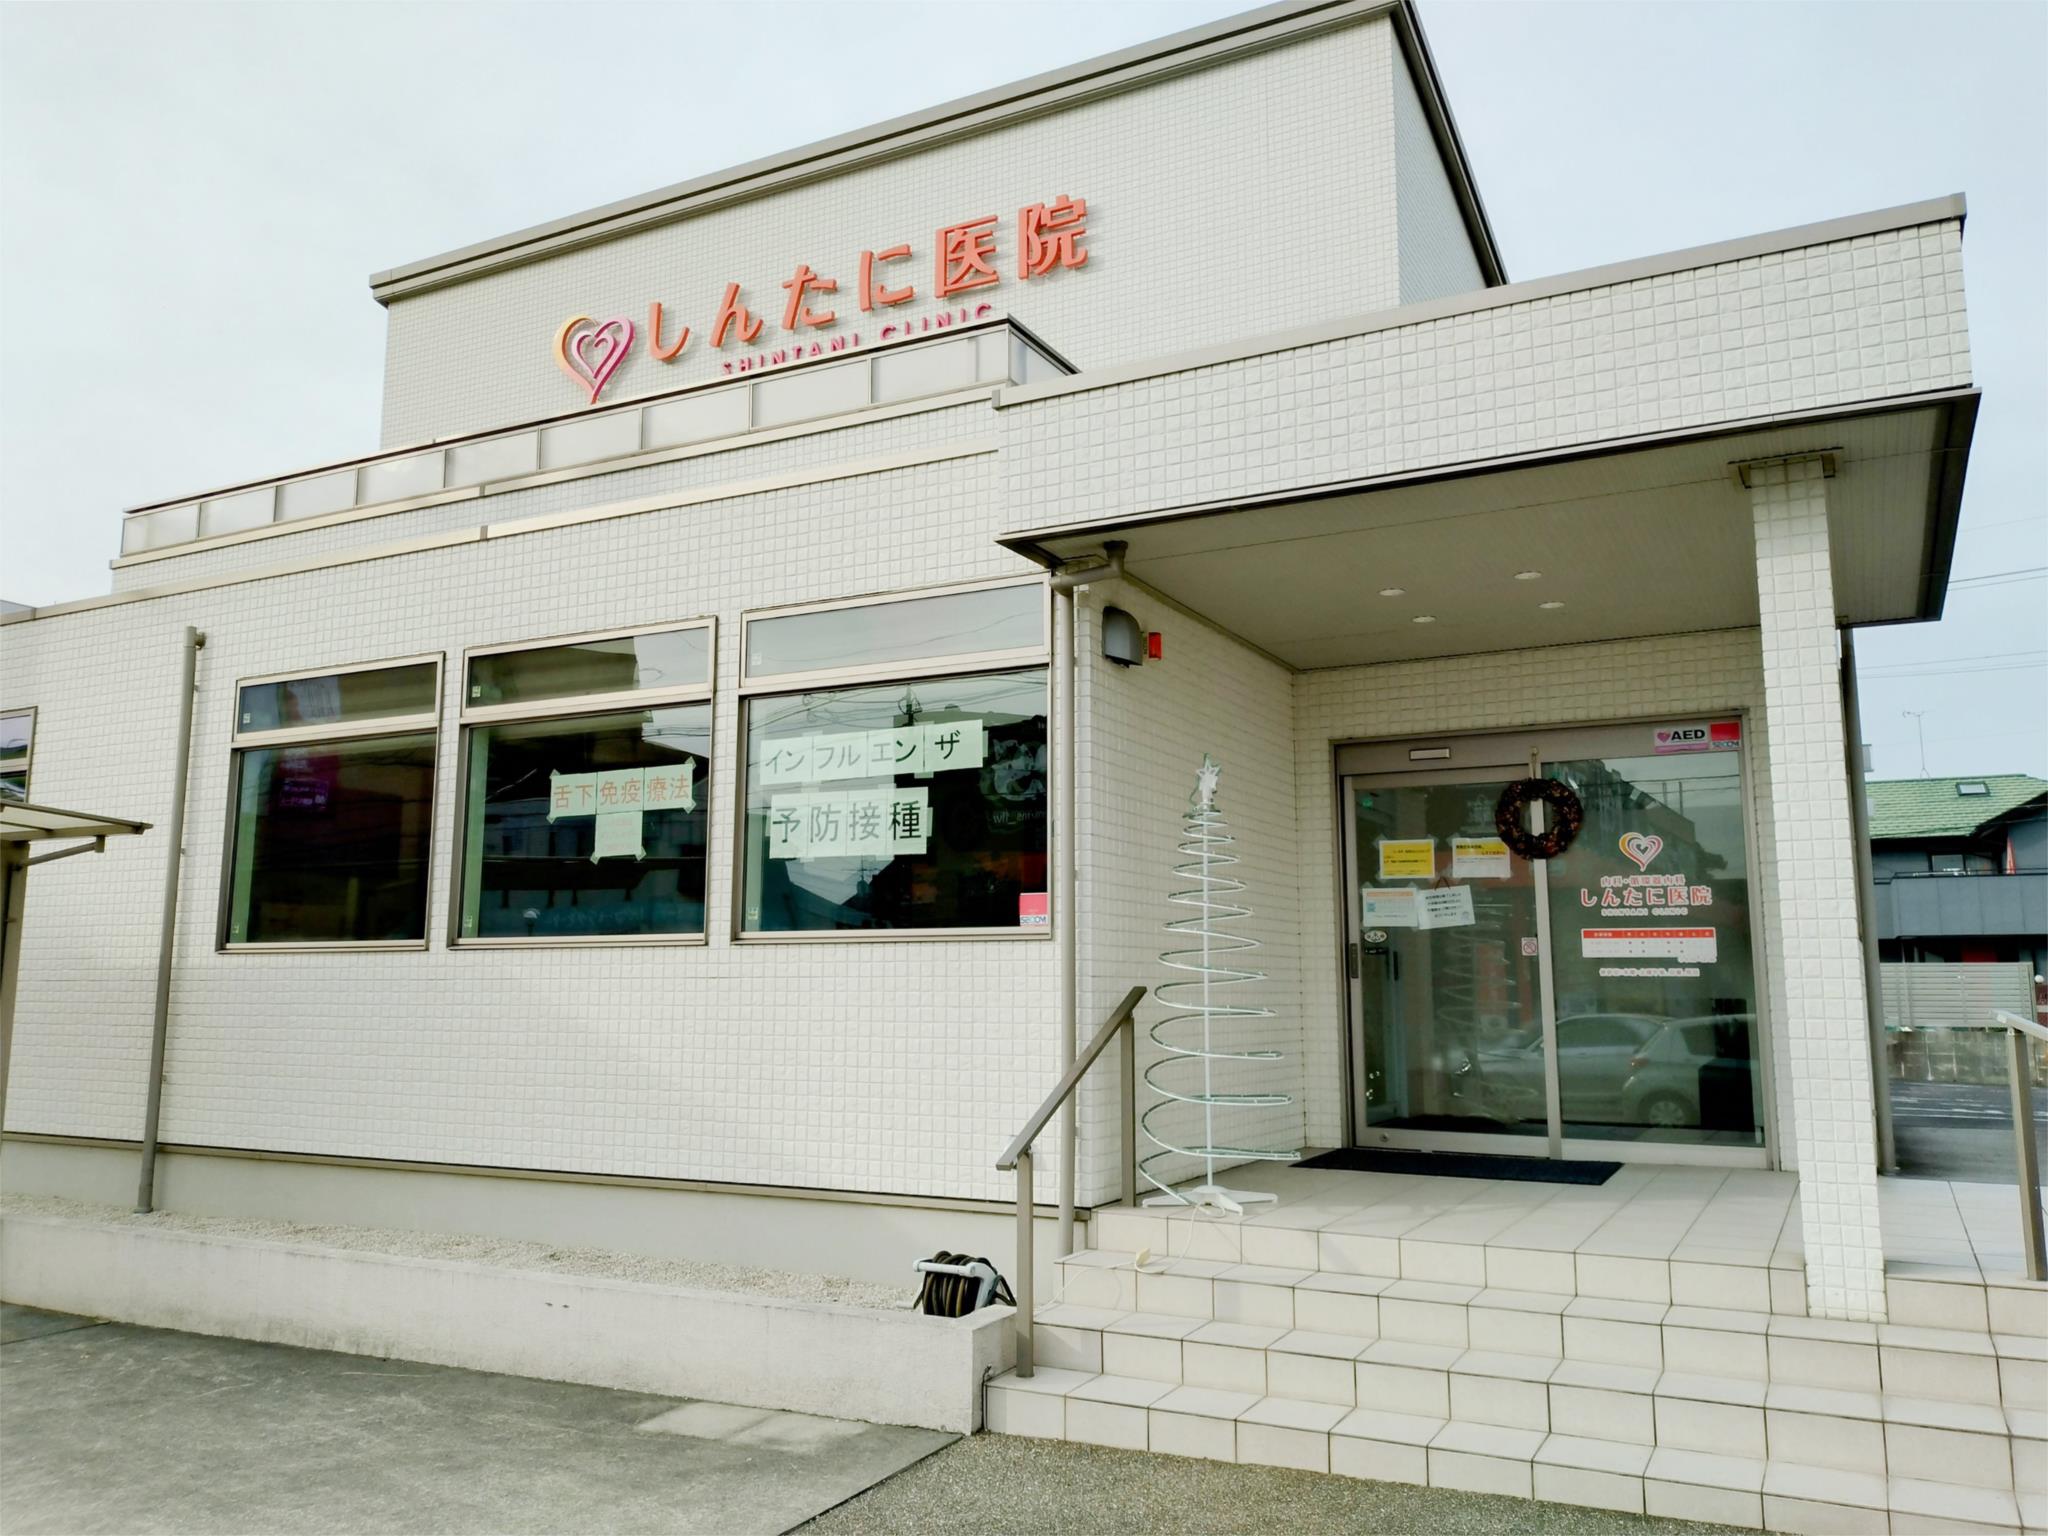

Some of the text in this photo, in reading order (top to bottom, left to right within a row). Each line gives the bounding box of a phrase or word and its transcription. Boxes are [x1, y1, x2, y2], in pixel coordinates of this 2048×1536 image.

[648, 194, 1088, 363] しんたに医院
[765, 729, 961, 775] インフルエンザ
[1671, 729, 1706, 741] AED
[553, 774, 690, 809] 舌下免疫療法
[772, 799, 922, 844] 予防接種
[1581, 885, 1712, 907] しんたに医院
